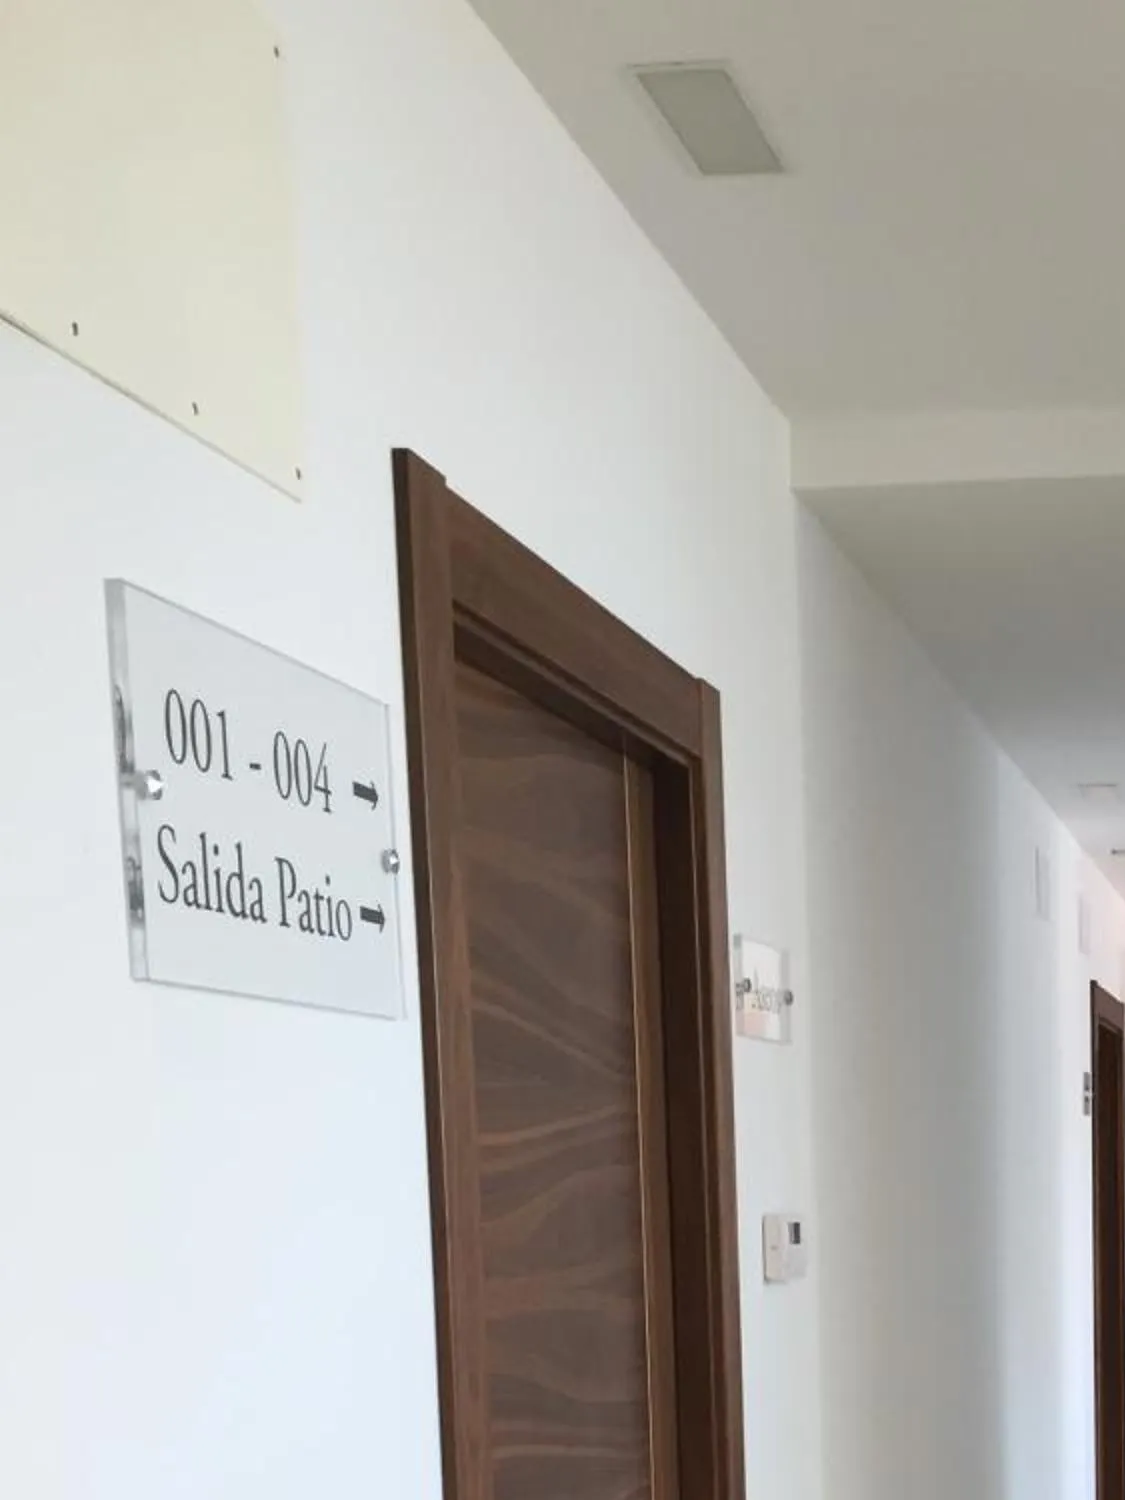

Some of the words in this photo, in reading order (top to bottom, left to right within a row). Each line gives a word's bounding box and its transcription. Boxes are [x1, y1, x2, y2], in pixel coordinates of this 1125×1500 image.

[165, 688, 233, 781] 001
[273, 730, 333, 814] 004
[157, 823, 268, 924] Salida
[274, 856, 353, 941] Patio
